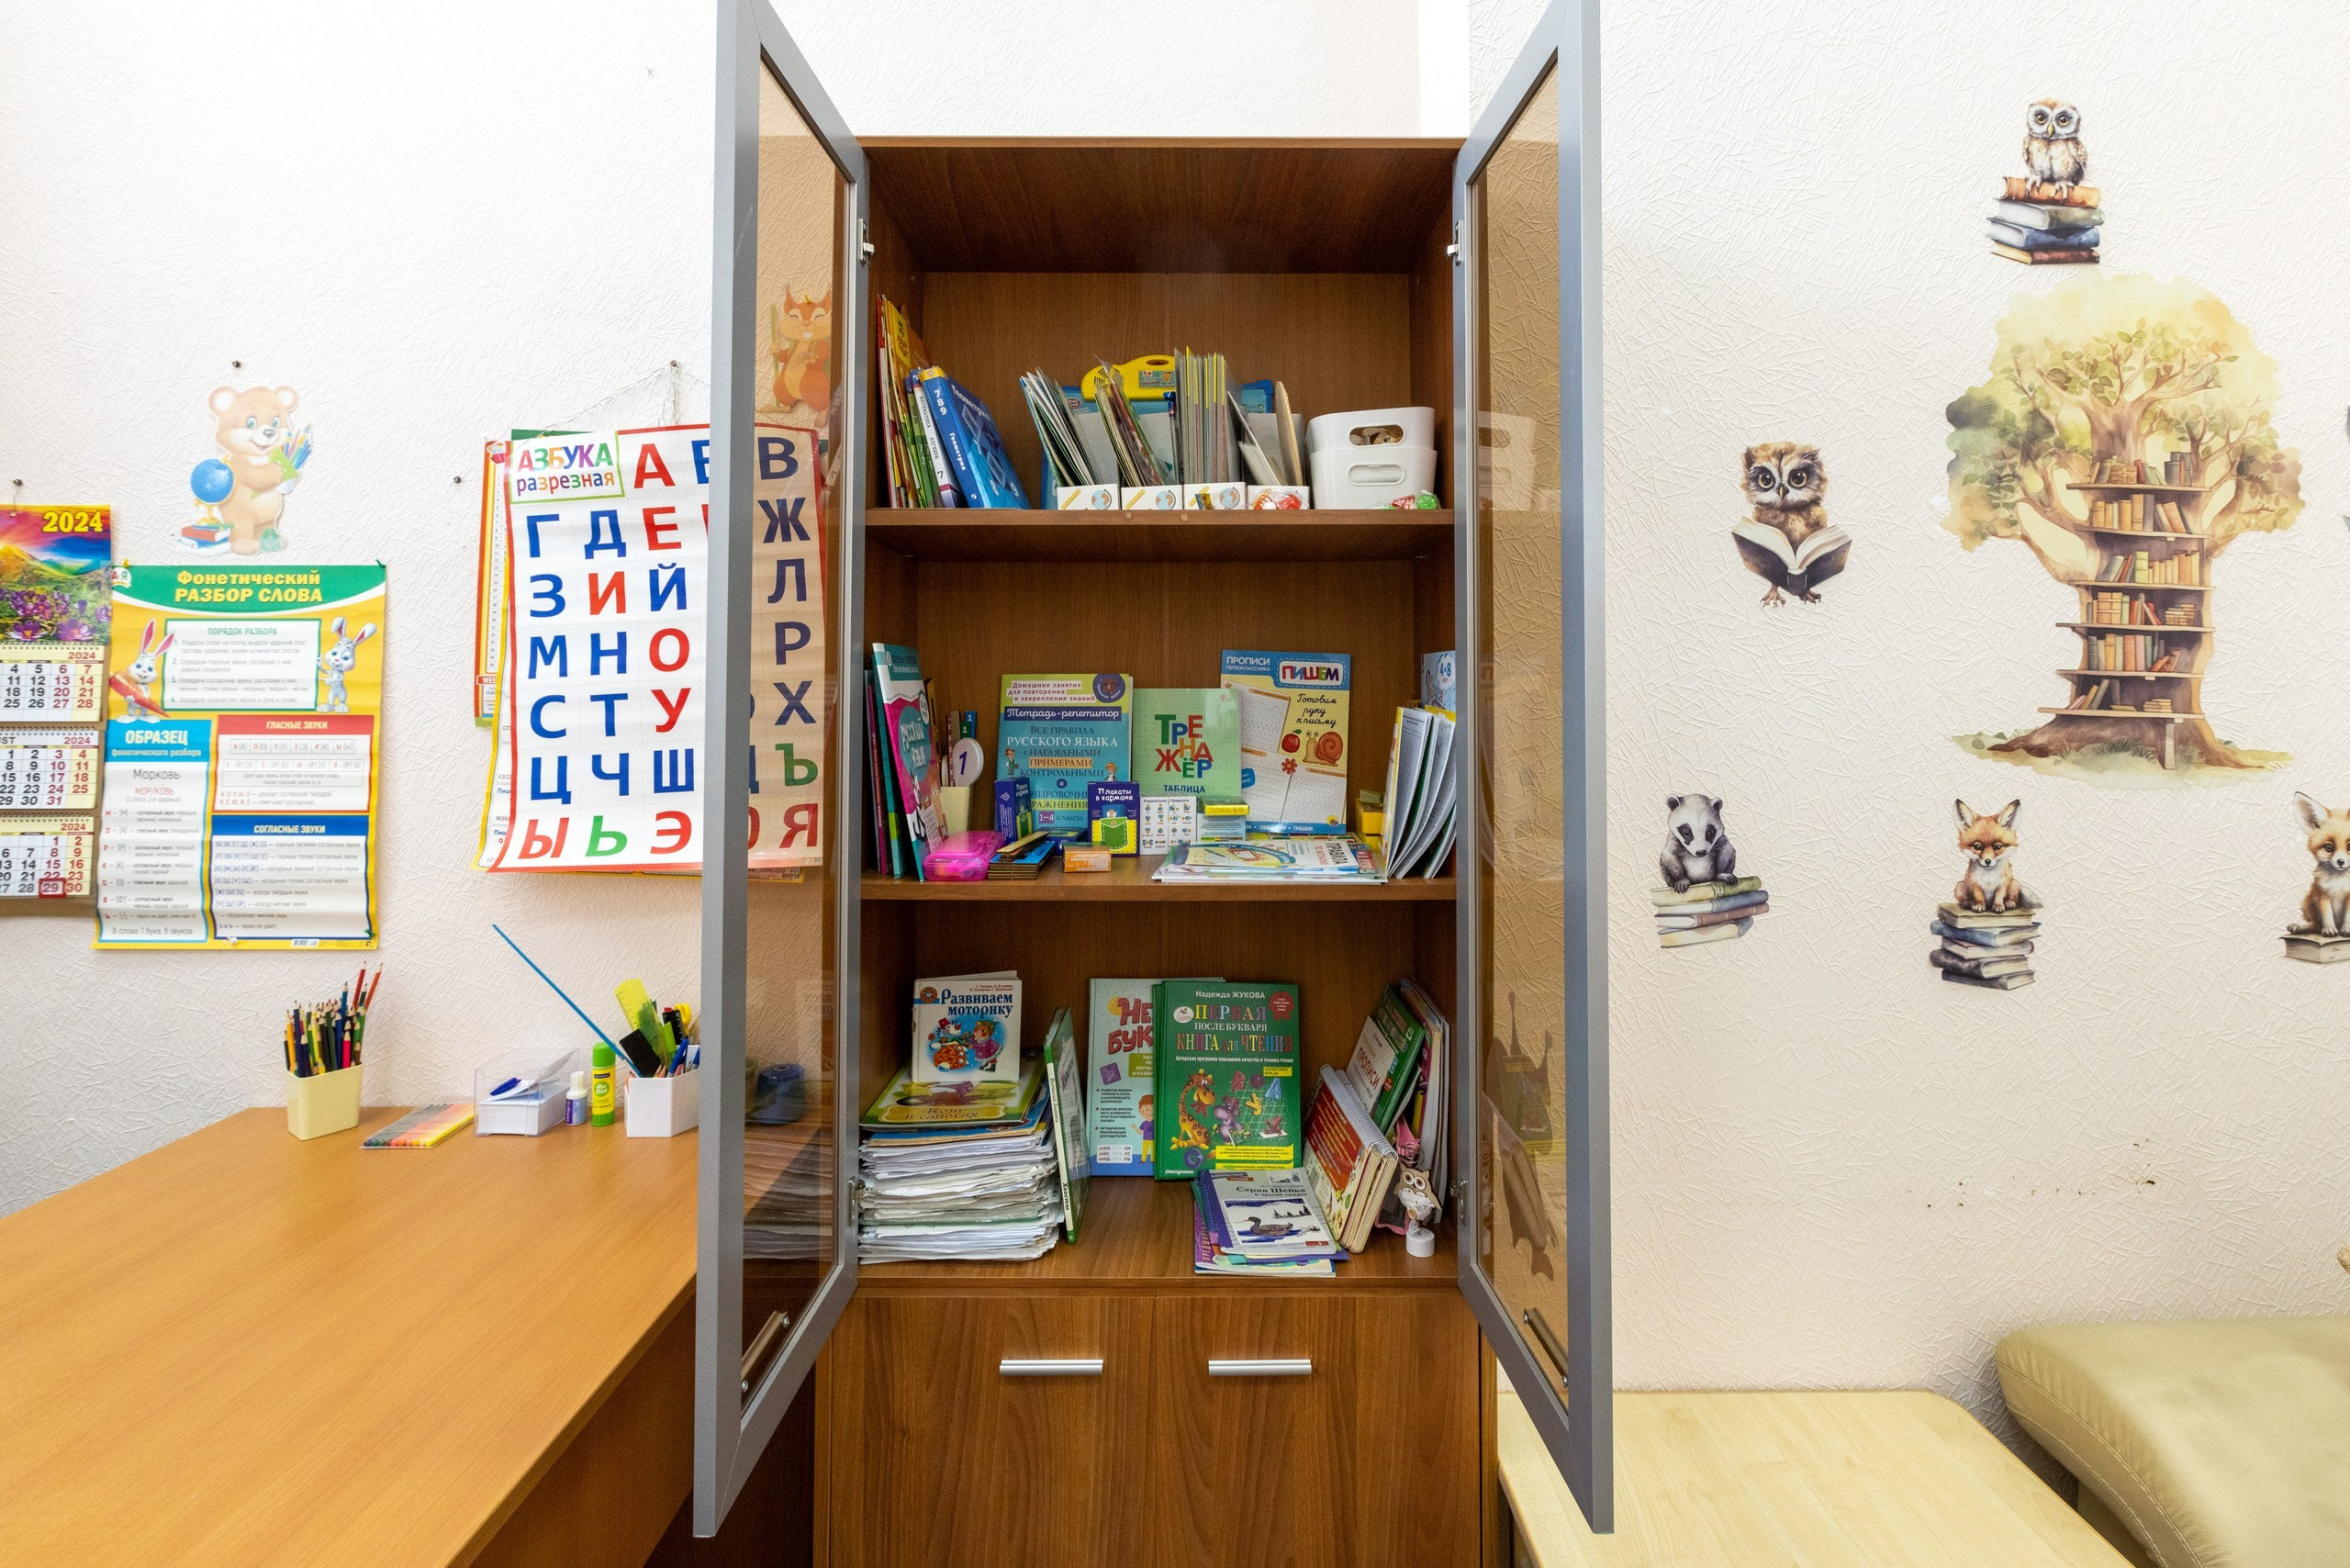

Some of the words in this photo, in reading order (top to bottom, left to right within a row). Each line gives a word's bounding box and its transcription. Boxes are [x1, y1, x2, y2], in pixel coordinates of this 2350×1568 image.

[517, 442, 613, 473] АЗБУКА
[949, 431, 967, 471] Геометрия
[633, 443, 675, 488] А
[757, 436, 799, 480] В
[516, 472, 615, 496] разрезная
[41, 510, 104, 533] 2024
[526, 513, 559, 558] Г
[584, 510, 626, 560] Д
[642, 506, 681, 551] Е
[757, 497, 811, 543] Ж
[177, 569, 320, 586] Фонетический
[174, 588, 254, 602] РАЗБОР
[258, 588, 323, 602] СЛОВА
[530, 574, 565, 618] З
[588, 571, 627, 616] И
[648, 562, 688, 611] Й
[767, 558, 807, 603] Л
[528, 634, 568, 679] М
[589, 631, 628, 677] Н
[648, 628, 690, 672] О
[774, 621, 811, 666] Р
[1226, 656, 1270, 665] ПРОПИСИ
[10, 665, 18, 674] 4
[35, 665, 42, 674] 5
[59, 665, 67, 674] 6
[84, 665, 92, 674] 7
[1282, 666, 1339, 681] ПИШЕМ
[7, 676, 20, 685] 11
[31, 676, 46, 685] 12
[55, 676, 70, 685] 13
[79, 676, 94, 685] 14
[6, 688, 20, 697] 18
[29, 688, 45, 697] 19
[53, 688, 70, 697] 20
[79, 688, 94, 697] 21
[1296, 694, 1337, 704] Готовим
[530, 694, 566, 739] С
[589, 692, 629, 737] Т
[650, 687, 692, 734] У
[772, 679, 817, 726] Х
[1302, 707, 1326, 716] руку
[1304, 718, 1337, 729] письму
[125, 730, 188, 745] ОБРАЗЕЦ
[1007, 736, 1071, 747] РУССКОГО
[1074, 736, 1118, 747] ЯЗЫКА
[8, 750, 15, 758] 1
[31, 750, 39, 758] 2
[55, 750, 62, 758] 3
[79, 750, 86, 758] 4
[6, 761, 14, 770] 8
[29, 761, 39, 770] 9
[50, 761, 66, 770] 10
[75, 761, 89, 770] 11
[959, 751, 968, 775] 1
[1, 773, 17, 782] 15
[26, 773, 40, 782] 16
[50, 773, 65, 782] 17
[73, 773, 89, 782] 18
[133, 769, 181, 781] Морковь
[530, 755, 572, 805] Ц
[591, 752, 630, 797] Ч
[653, 748, 695, 794] Ш
[775, 743, 819, 787] Ъ
[1164, 785, 1205, 793] ТАБЛИЦА
[253, 825, 299, 834] СОГЛАСНЫЕ
[301, 825, 326, 834] ЗВУКИ
[518, 817, 569, 860] Ы
[585, 815, 629, 857] Ь
[649, 810, 693, 855] Э
[778, 802, 819, 849] Я
[53, 836, 59, 846] 1
[74, 836, 83, 846] 2
[2, 848, 10, 857] 6
[26, 848, 35, 857] 7
[50, 848, 59, 857] 8
[73, 848, 82, 857] 9
[22, 860, 37, 869] 14
[46, 860, 61, 869] 15
[70, 860, 84, 869] 16
[941, 989, 1013, 1004] Развиваем
[948, 1005, 1013, 1019] моторику
[1195, 1004, 1267, 1021] ПЕРВАЯ
[1226, 1024, 1267, 1032] БУКВАРЯ
[1108, 1025, 1153, 1056] БУК
[1177, 1034, 1219, 1050] КНИГА
[1241, 1036, 1292, 1052] ЧТЕНИЯ
[1357, 1047, 1381, 1091] ПРОПИСИ
[1062, 1182, 1070, 1210] Хвосты
